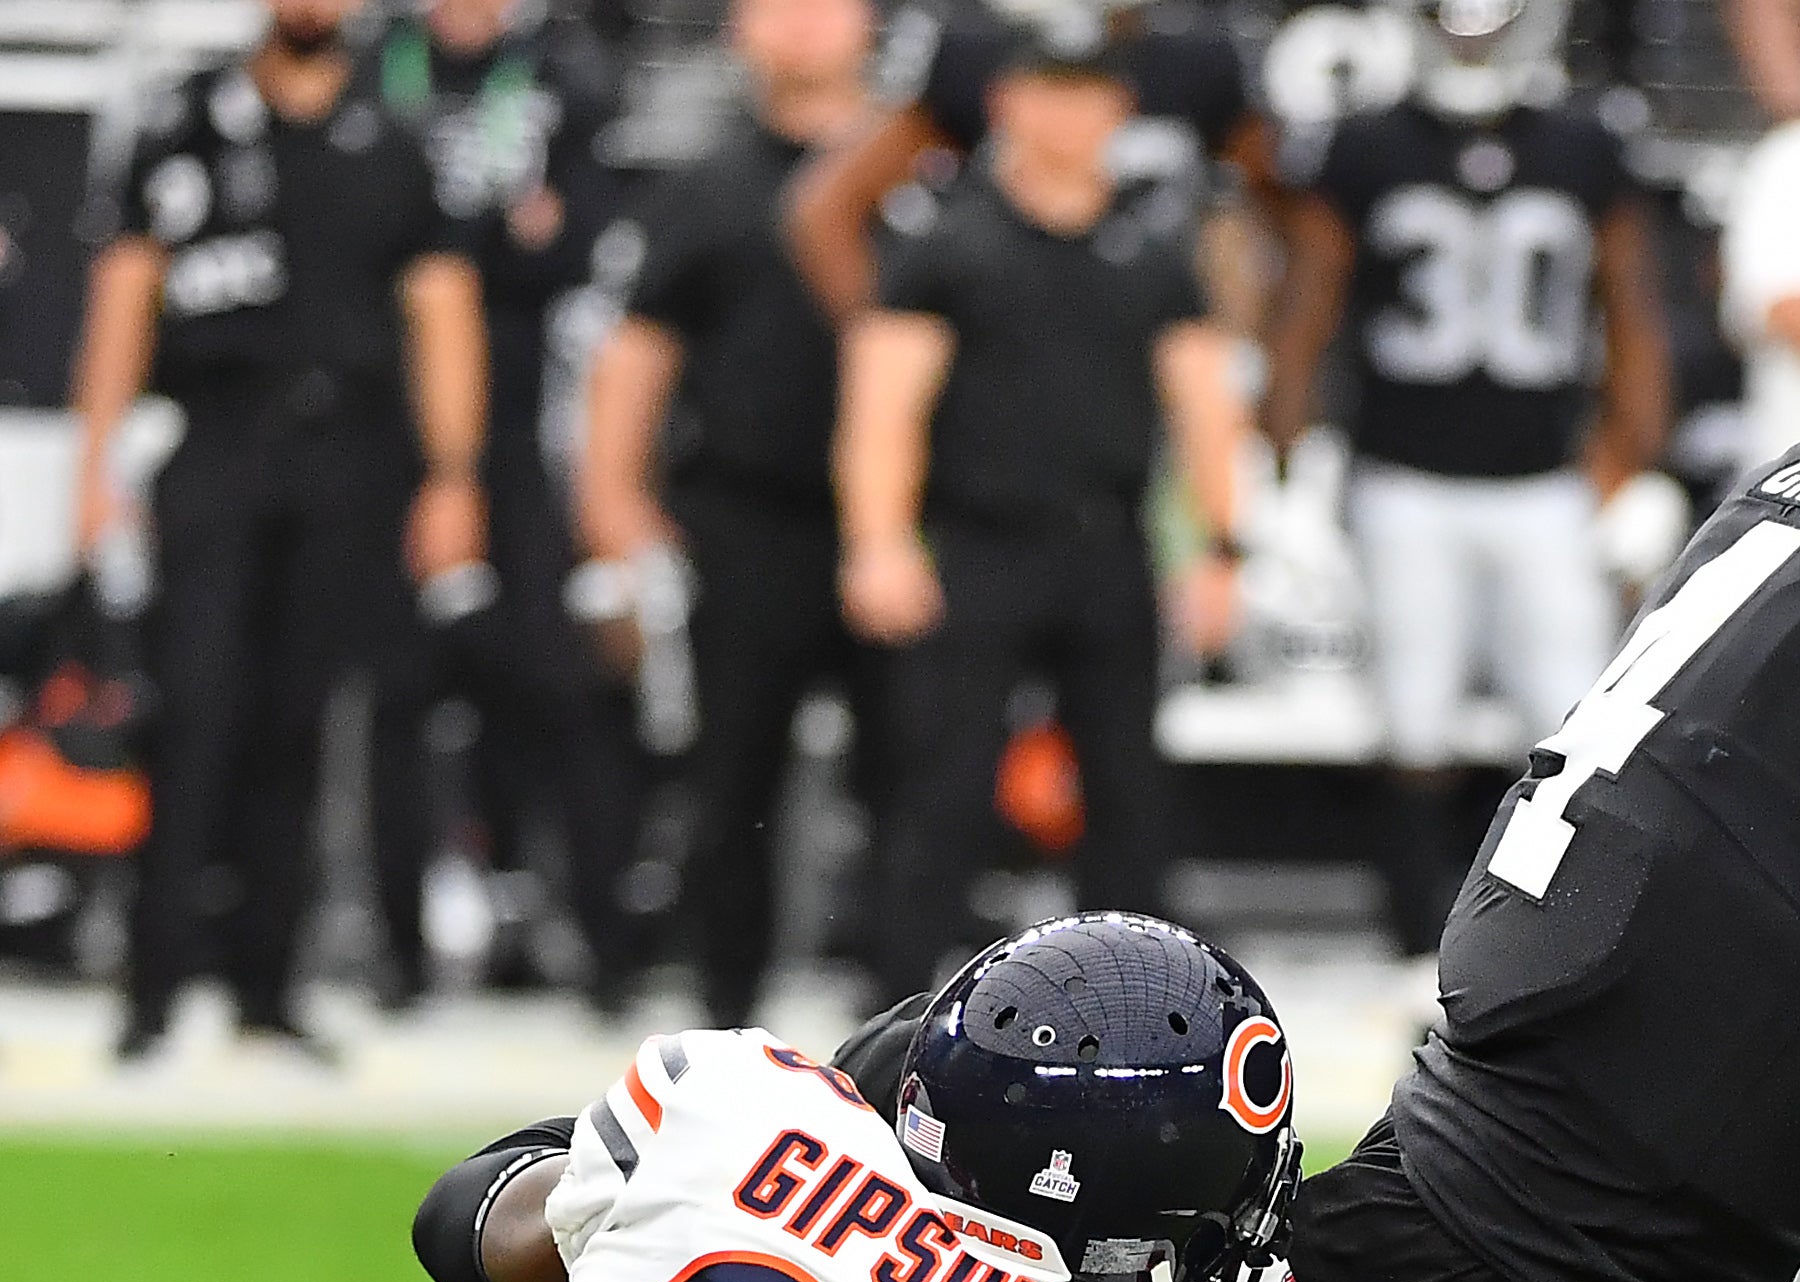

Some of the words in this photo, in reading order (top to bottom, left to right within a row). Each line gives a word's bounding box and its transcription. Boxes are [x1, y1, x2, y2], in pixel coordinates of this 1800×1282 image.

[1362, 182, 1592, 389] 30
[1034, 1176, 1077, 1195] CATCH
[944, 1211, 1043, 1261] EARS
